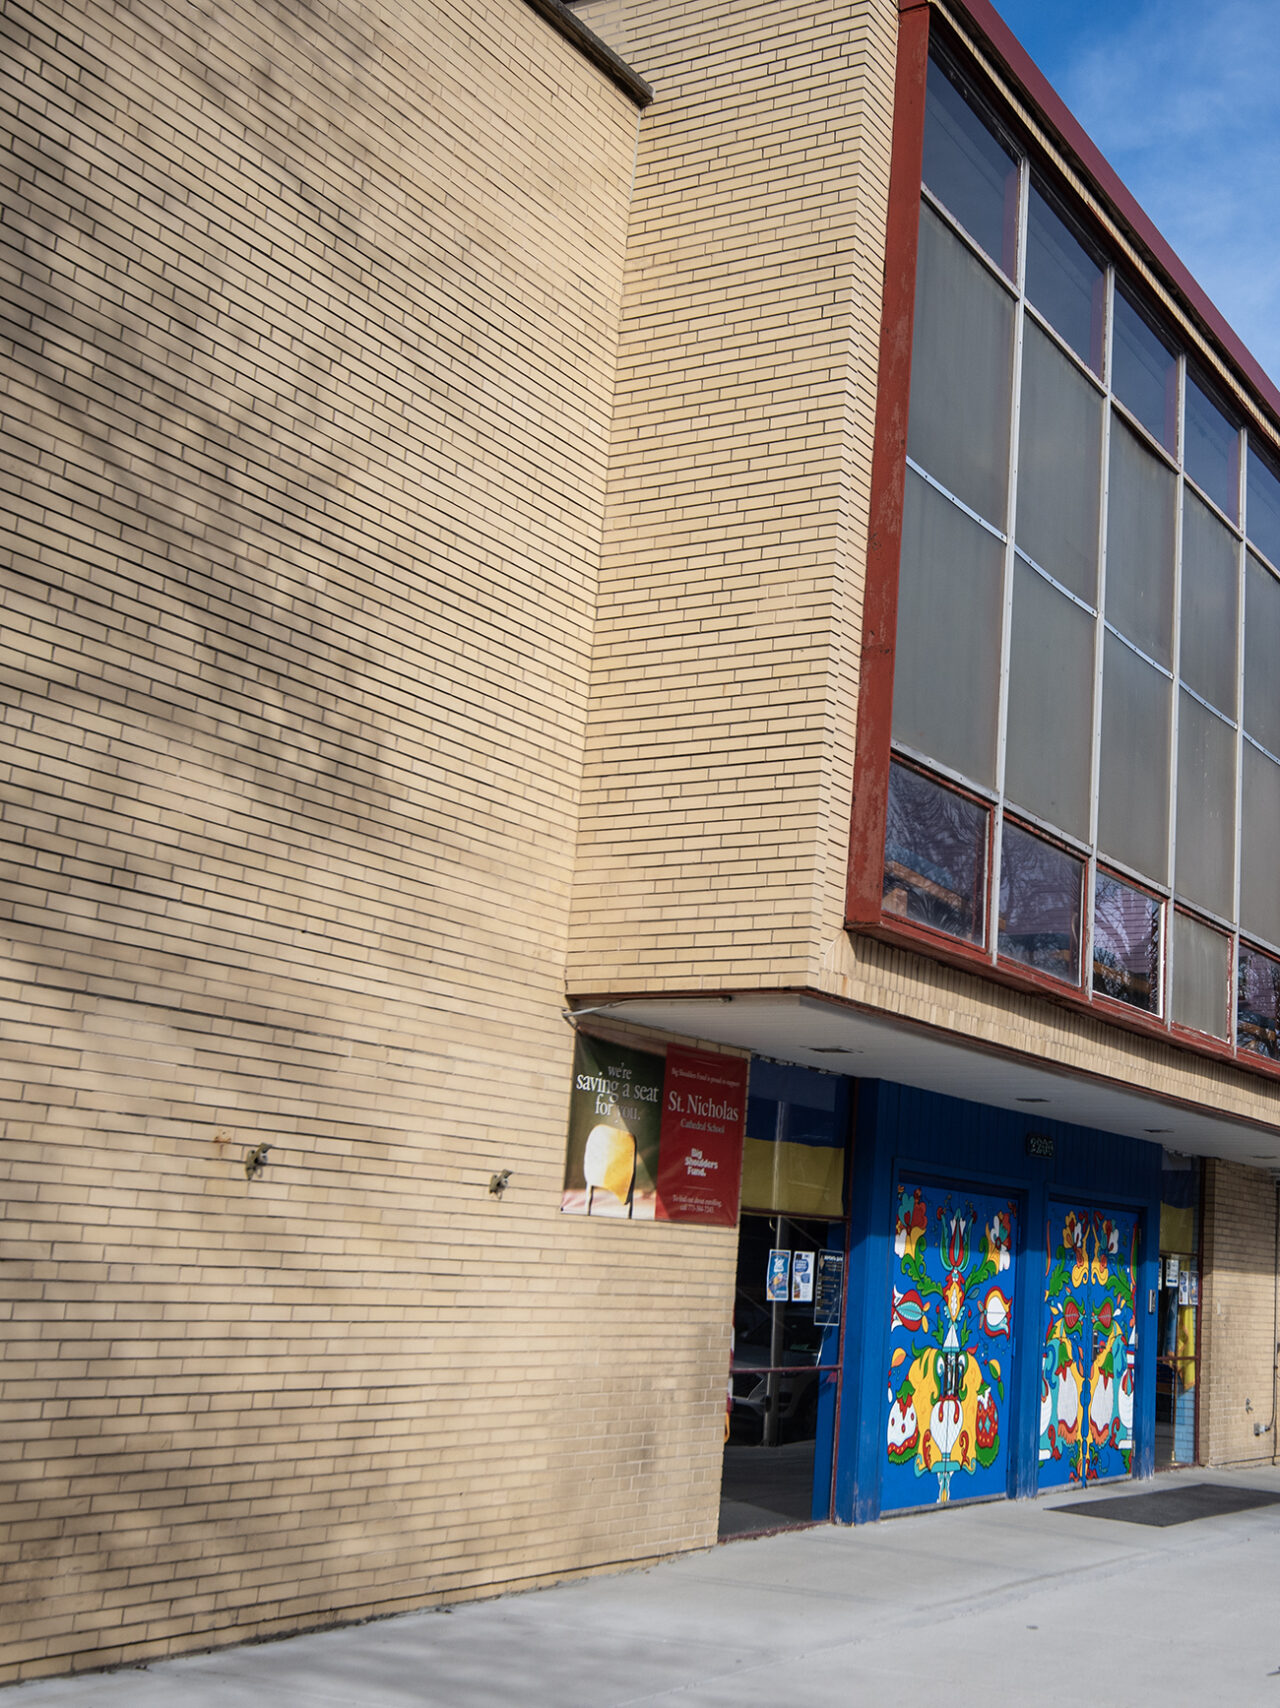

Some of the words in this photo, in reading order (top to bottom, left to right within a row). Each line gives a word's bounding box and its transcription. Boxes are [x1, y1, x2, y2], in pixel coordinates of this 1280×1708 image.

[608, 1062, 633, 1080] we're
[576, 1071, 620, 1103] saving
[622, 1083, 630, 1098] a
[633, 1084, 659, 1103] seat
[594, 1093, 615, 1116] for
[614, 1105, 641, 1124] you.
[668, 1090, 684, 1113] St.
[686, 1094, 739, 1122] Nicholas
[680, 1118, 706, 1132] Cathedral
[706, 1122, 725, 1134] School
[691, 1148, 703, 1159] Big
[684, 1156, 719, 1170] Shoulders
